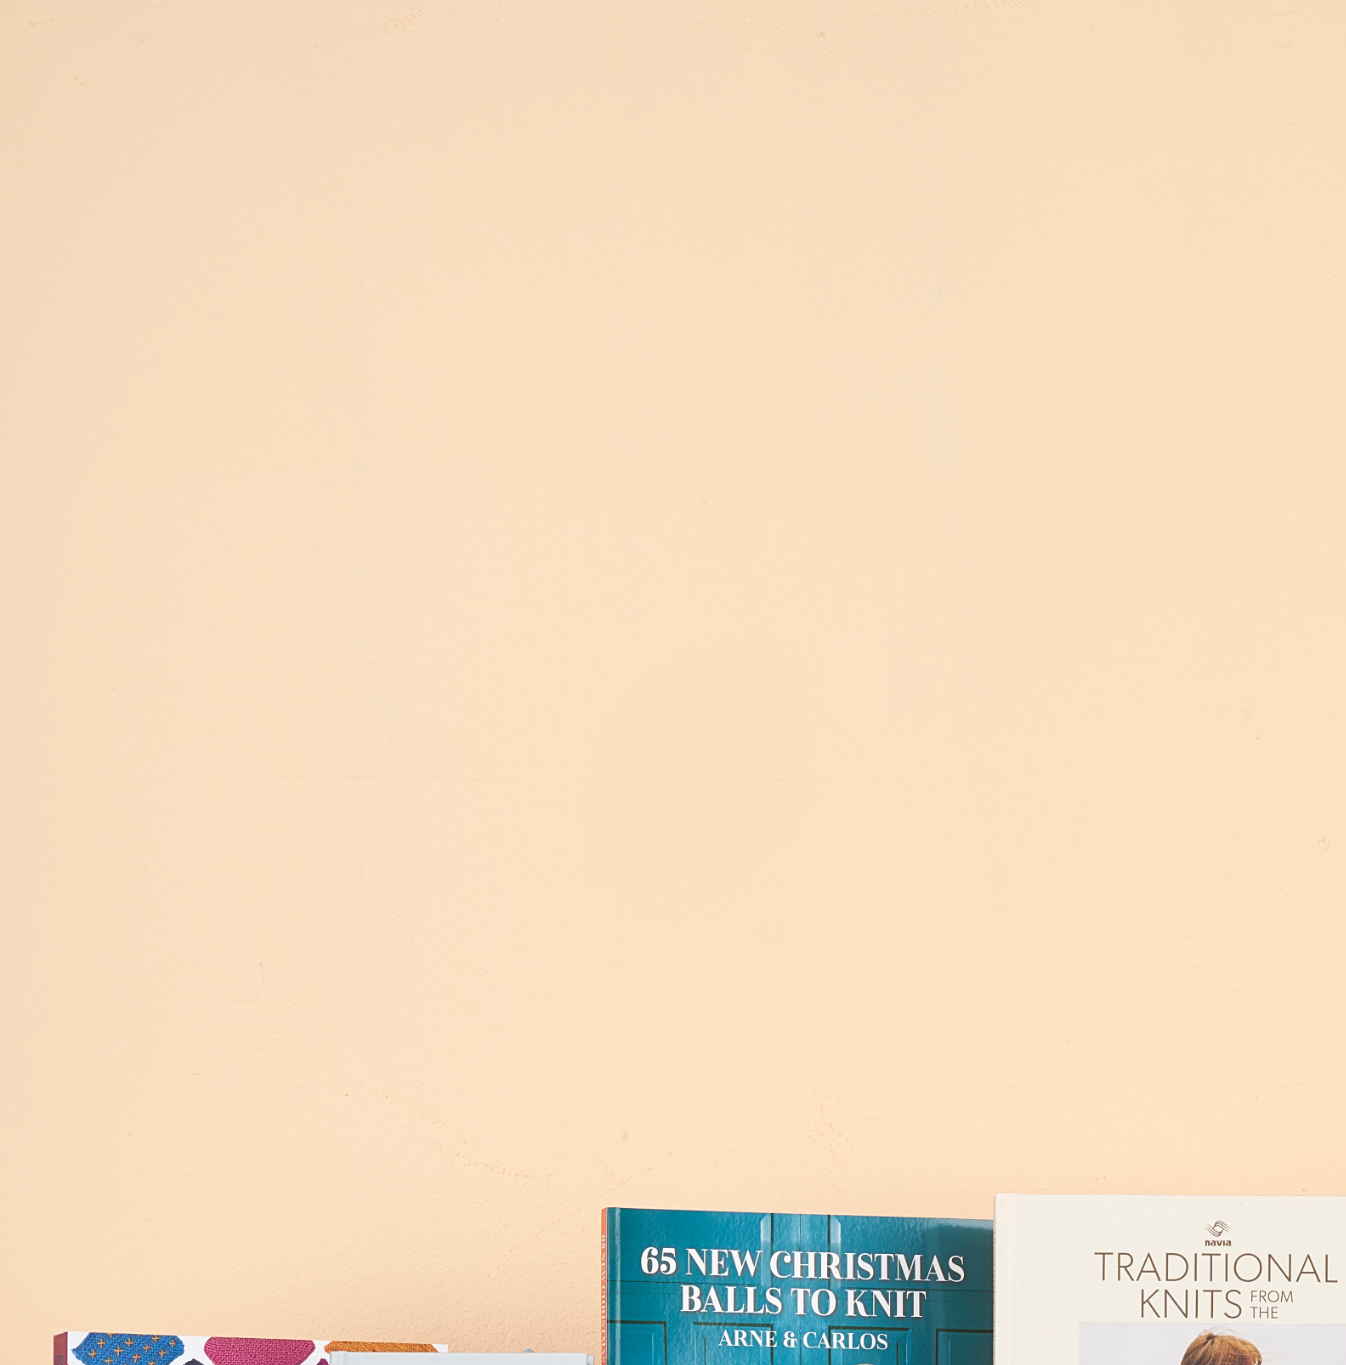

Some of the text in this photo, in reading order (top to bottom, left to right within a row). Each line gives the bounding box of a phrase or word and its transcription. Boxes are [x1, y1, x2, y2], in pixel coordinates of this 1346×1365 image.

[641, 1247, 965, 1283] 65 NEW CHRISTMAS
[1094, 1252, 1339, 1284] TRADITIONAL
[680, 1285, 927, 1318] BALLS TO KNIT
[1141, 1289, 1242, 1320] KNITS
